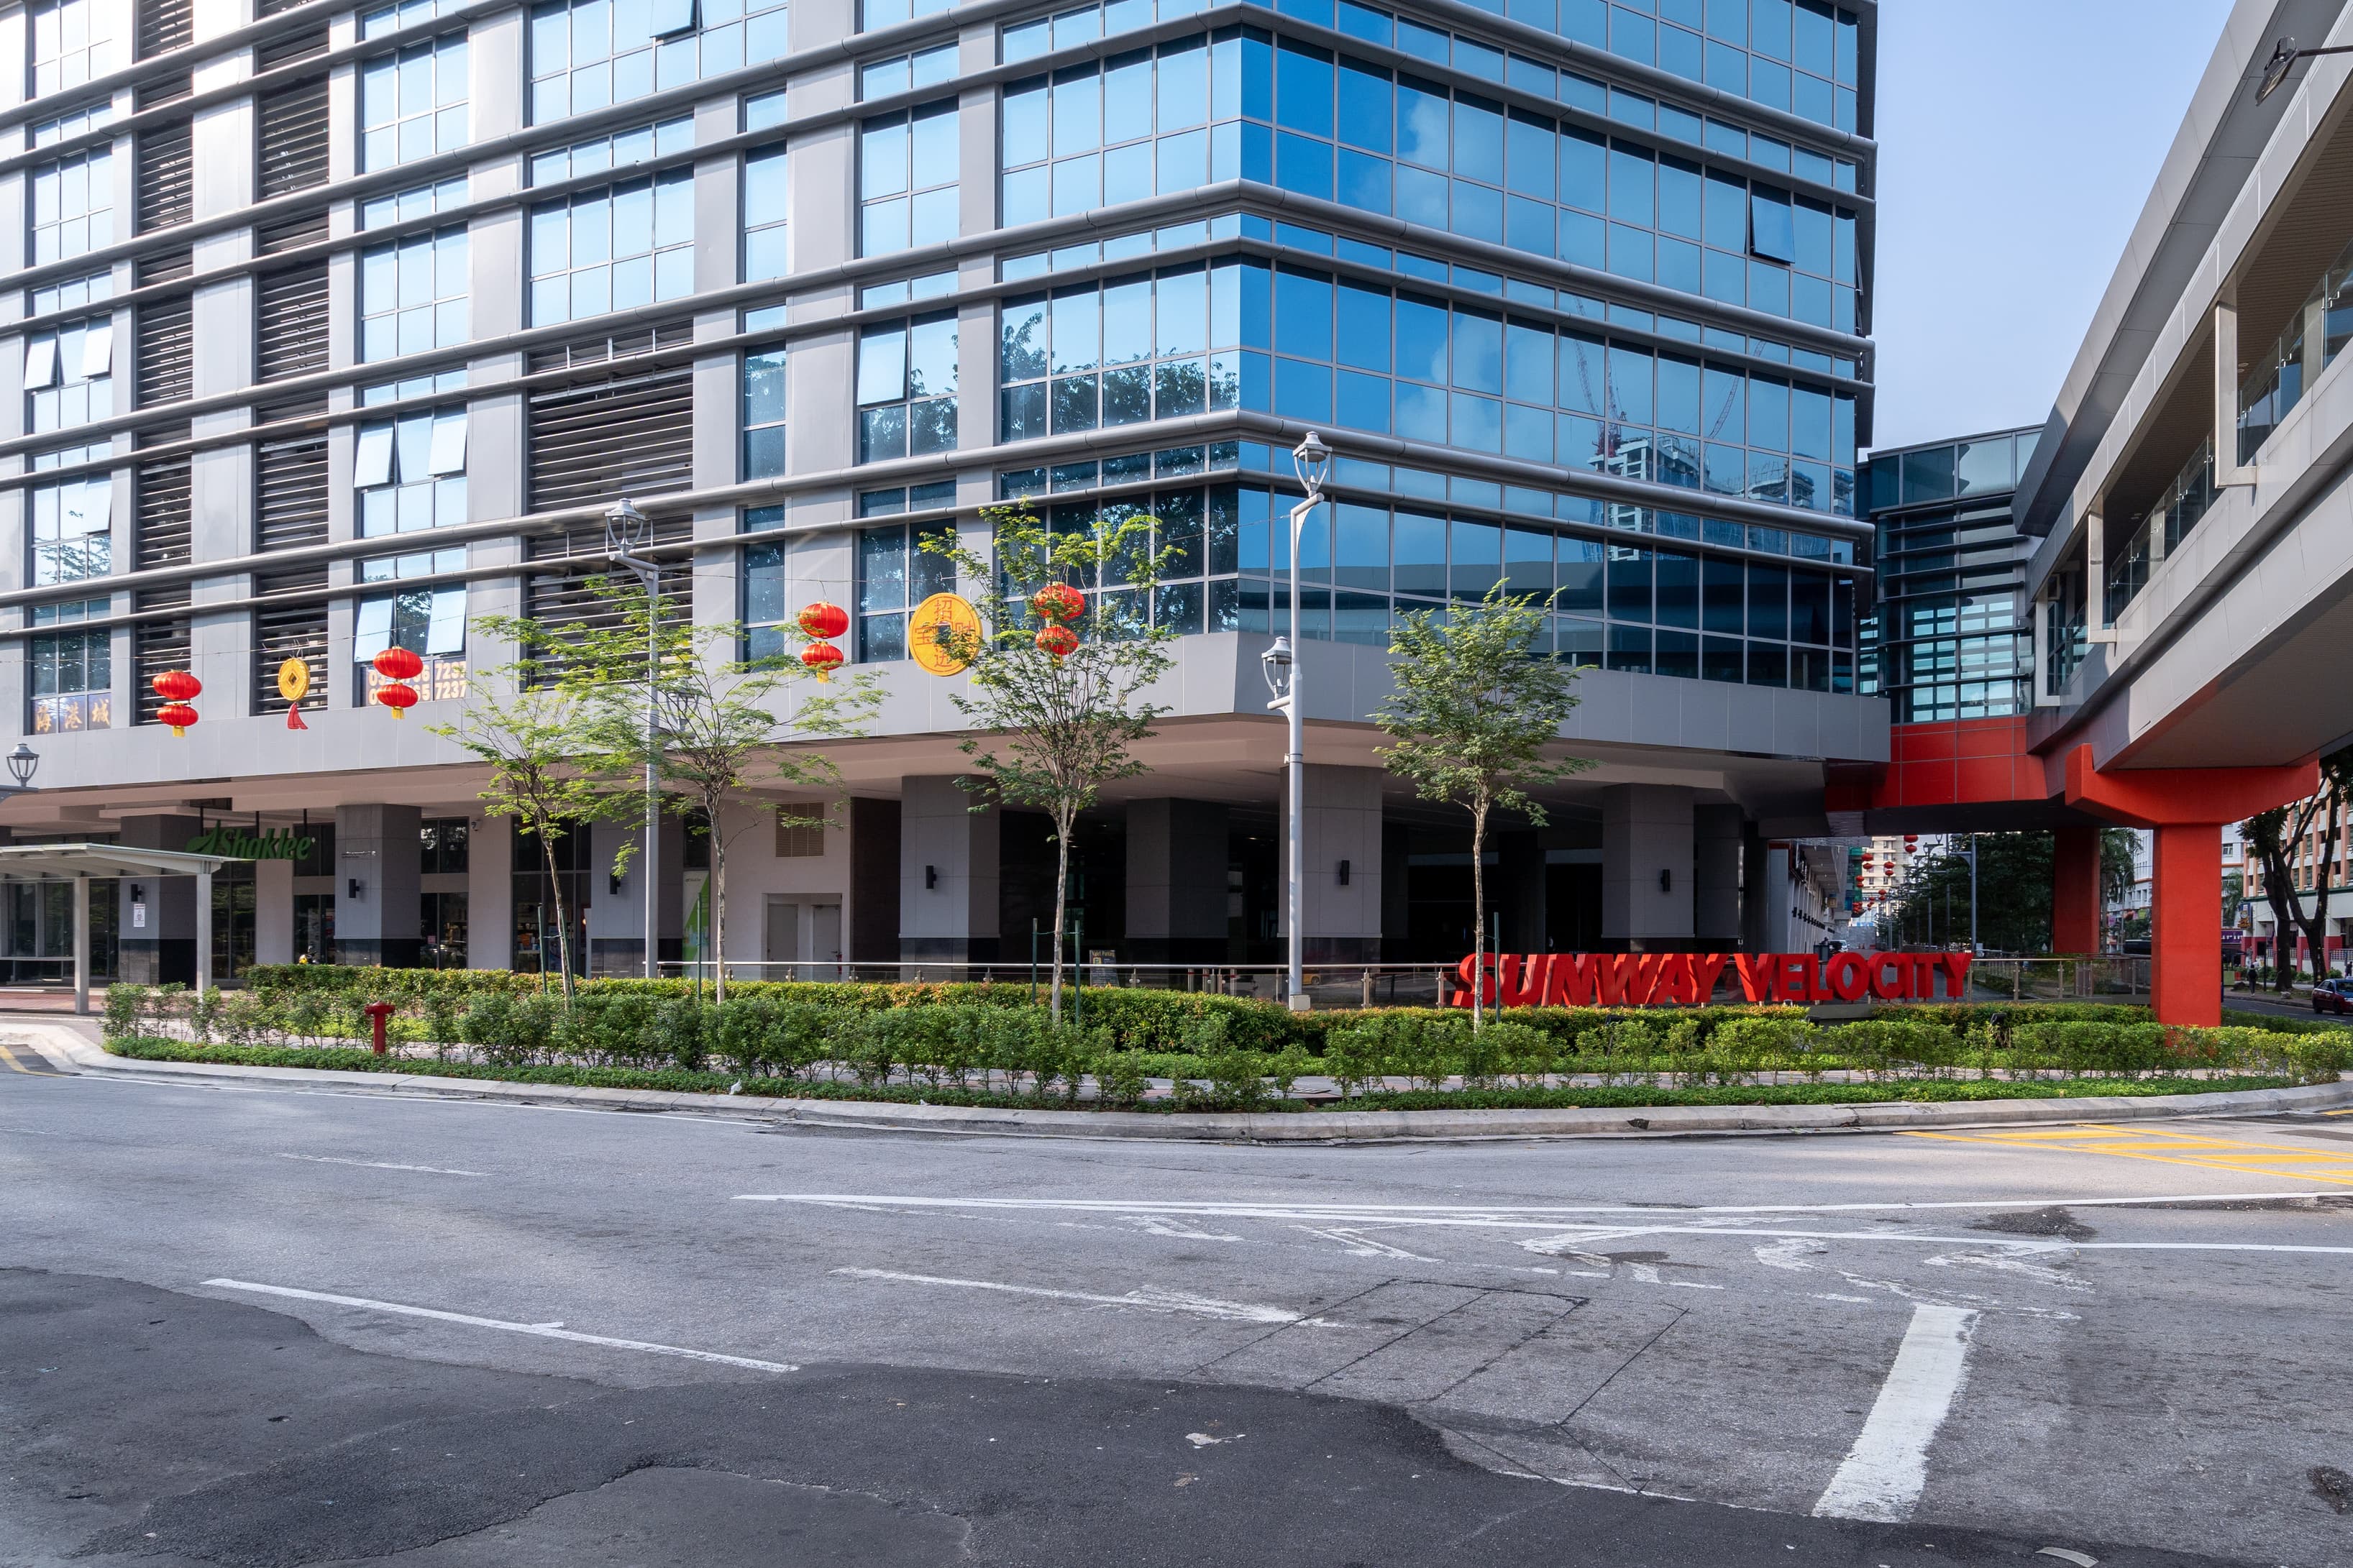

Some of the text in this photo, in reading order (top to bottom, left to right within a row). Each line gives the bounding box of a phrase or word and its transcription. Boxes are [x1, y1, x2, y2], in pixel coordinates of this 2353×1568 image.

[218, 828, 311, 861] Shaklee
[1451, 952, 1973, 1007] SUNWAY VELOCITY
